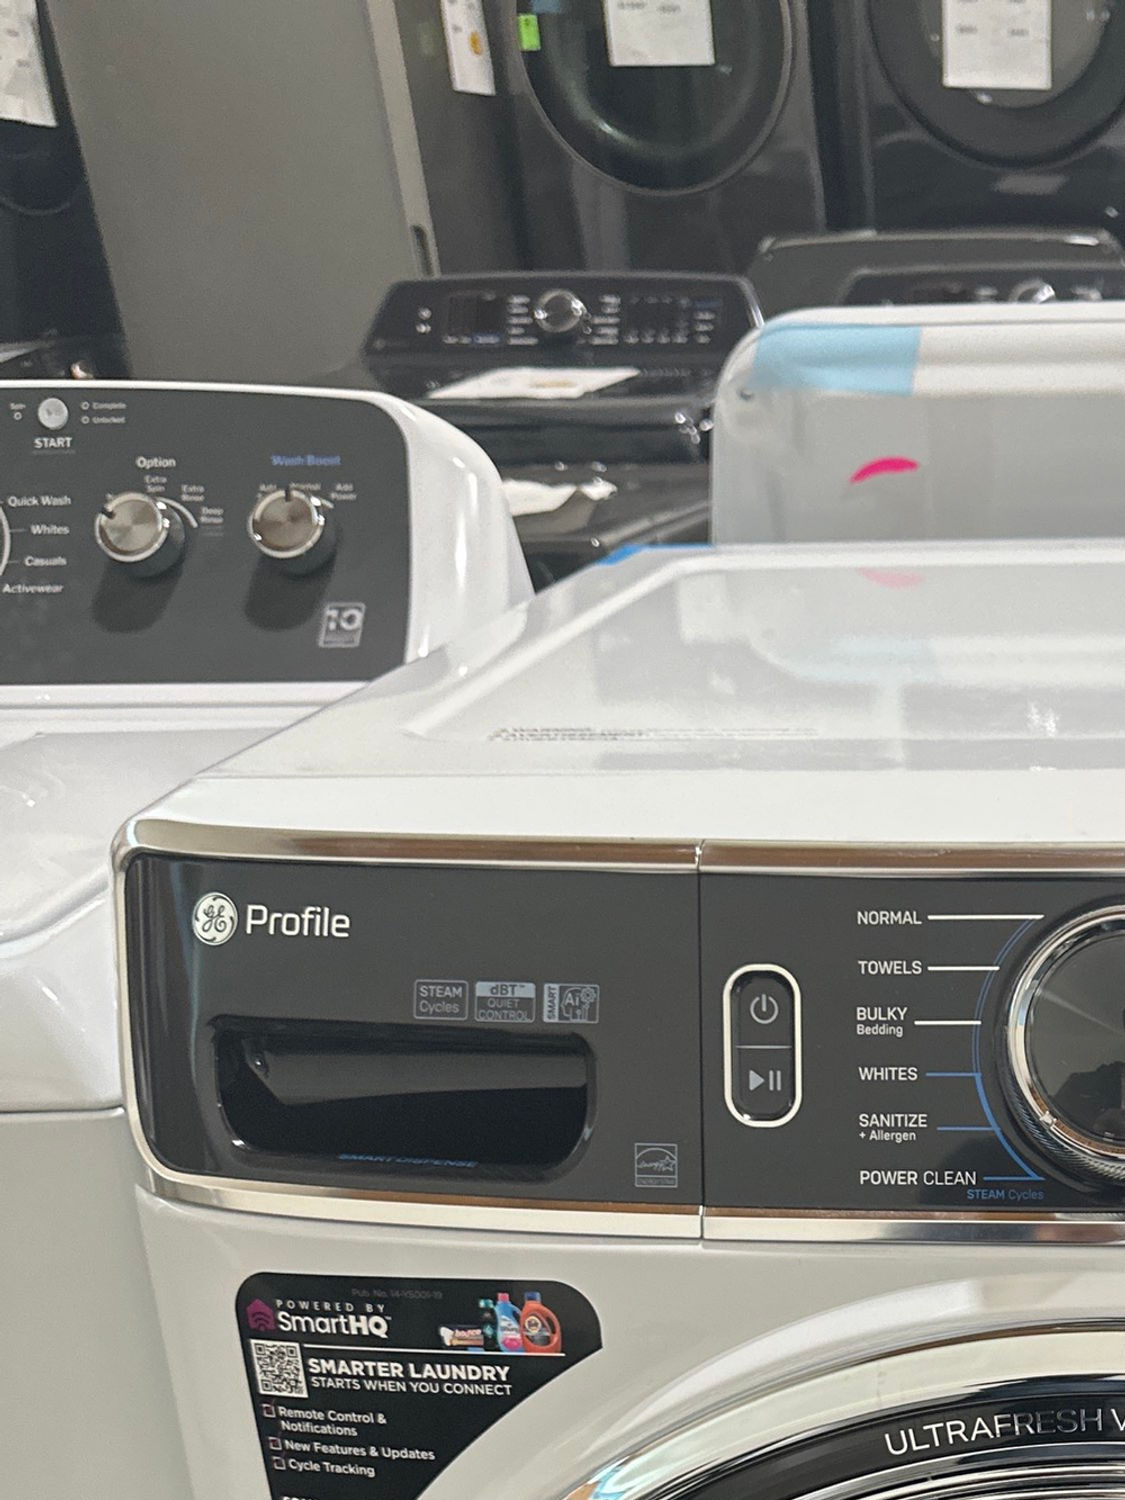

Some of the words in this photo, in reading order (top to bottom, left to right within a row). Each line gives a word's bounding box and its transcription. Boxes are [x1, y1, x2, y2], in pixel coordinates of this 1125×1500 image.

[33, 437, 72, 449] START
[136, 456, 176, 469] Option
[8, 496, 39, 507] Quick
[41, 496, 71, 505] Wash
[31, 524, 70, 535] Whites
[25, 556, 67, 566] Casuals
[2, 584, 63, 593] Activewear
[246, 904, 350, 938] Profile
[856, 910, 922, 925] NORMAL
[858, 960, 922, 975] TOWELS
[419, 985, 463, 998] STEAM
[419, 1001, 459, 1014] Cycles
[487, 998, 519, 1008] QUIET
[546, 986, 558, 1020] SMART
[478, 1010, 530, 1021] CONTROL
[856, 1007, 907, 1021] BULKY
[856, 1024, 903, 1037] Bedding
[858, 1067, 918, 1081] WHITES
[858, 1114, 928, 1127] SANITIZE
[869, 1129, 917, 1142] Allergen
[860, 1171, 918, 1185] POWER
[923, 1171, 977, 1185] CLEAN
[967, 1189, 1005, 1200] STEAM
[1008, 1189, 1044, 1201] Cycles
[276, 1300, 355, 1312] POWERED
[366, 1304, 385, 1312] BY
[308, 1358, 404, 1378] SMARTER
[409, 1363, 510, 1381] LAUNDRY
[311, 1378, 361, 1390] STARTS
[363, 1380, 407, 1393] WHEN
[409, 1382, 440, 1394] YOU
[443, 1383, 512, 1396] CONNECT
[278, 1406, 325, 1420] Remote
[328, 1410, 375, 1424] Control
[377, 1413, 387, 1424] &
[281, 1421, 358, 1436] Notifications
[884, 1407, 1103, 1457] ULTRAFRESH
[284, 1440, 311, 1452] New
[313, 1443, 367, 1456] Features
[369, 1446, 379, 1457] &
[381, 1447, 436, 1460] Updates
[288, 1459, 321, 1472] Cycle
[323, 1462, 375, 1478] Tracking
